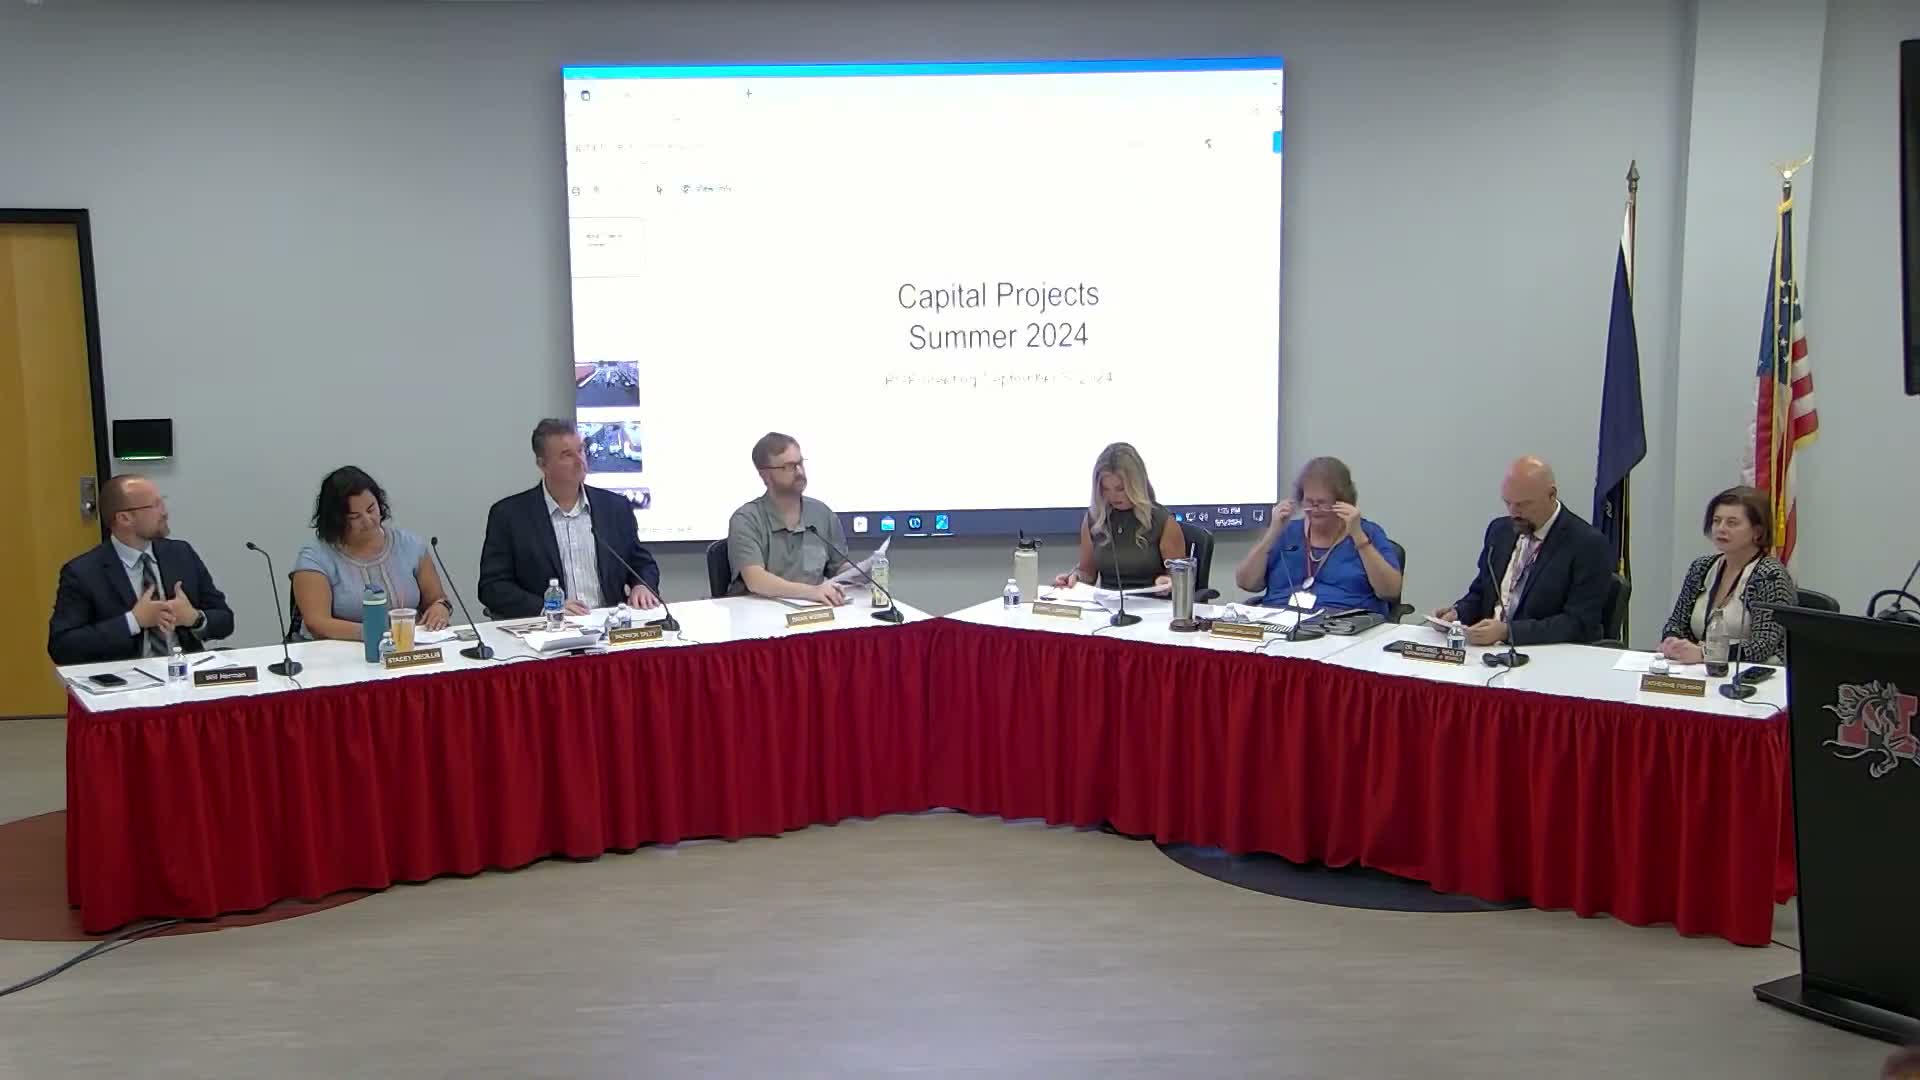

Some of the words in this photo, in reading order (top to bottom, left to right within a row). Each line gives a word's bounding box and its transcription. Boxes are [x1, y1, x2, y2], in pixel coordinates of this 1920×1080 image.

[899, 282, 986, 314] Capital
[997, 281, 1100, 314] Projects
[909, 324, 1018, 350] Summer
[1026, 321, 1089, 348] 2024
